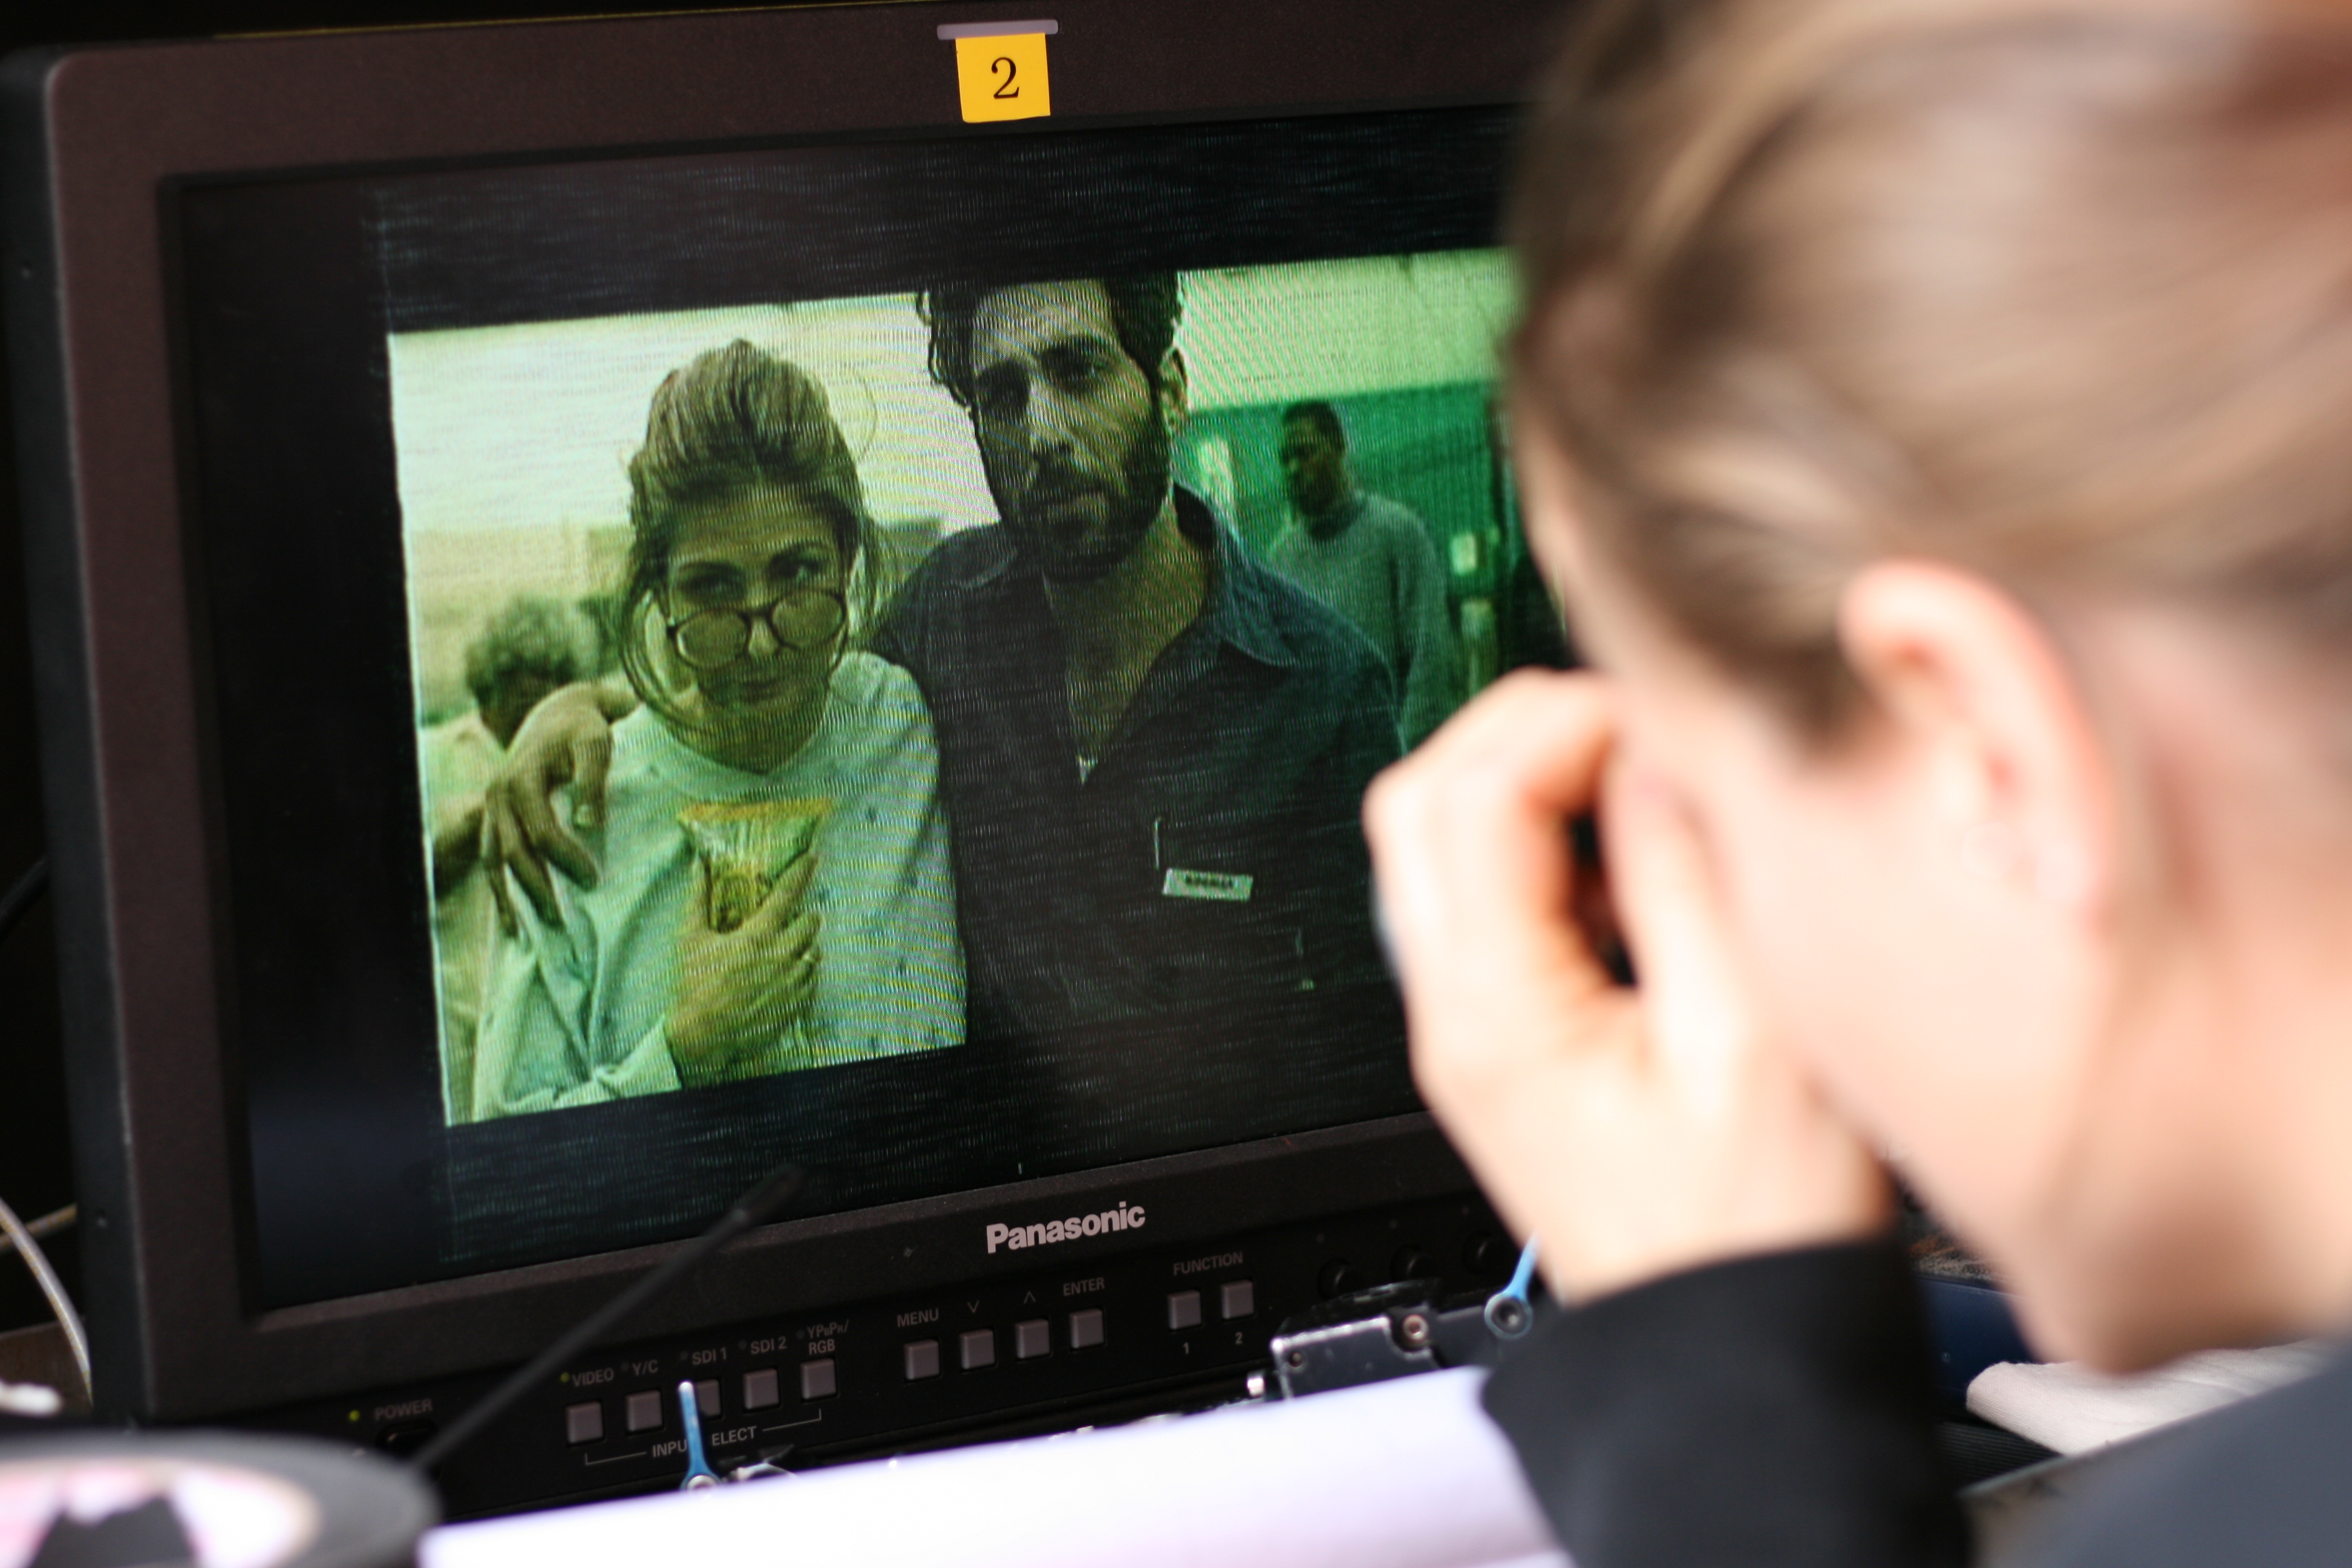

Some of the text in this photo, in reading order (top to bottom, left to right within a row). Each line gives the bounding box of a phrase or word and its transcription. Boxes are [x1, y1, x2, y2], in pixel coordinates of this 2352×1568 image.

[990, 56, 1020, 100] 2
[985, 1201, 1146, 1254] Panasonic
[1172, 1251, 1244, 1276] FUNCTION
[1062, 1277, 1105, 1297] ENTER
[896, 1308, 939, 1328] MENU
[750, 1335, 788, 1356] SDI 2
[808, 1339, 836, 1356] RGB
[1234, 1331, 1244, 1345] 2
[691, 1346, 728, 1366] SDI 1
[1182, 1342, 1191, 1355] 1
[571, 1367, 615, 1388] VIDEO
[632, 1359, 660, 1377] Y/C
[373, 1397, 434, 1421] POWER
[652, 1425, 758, 1458] INPU ELECT
